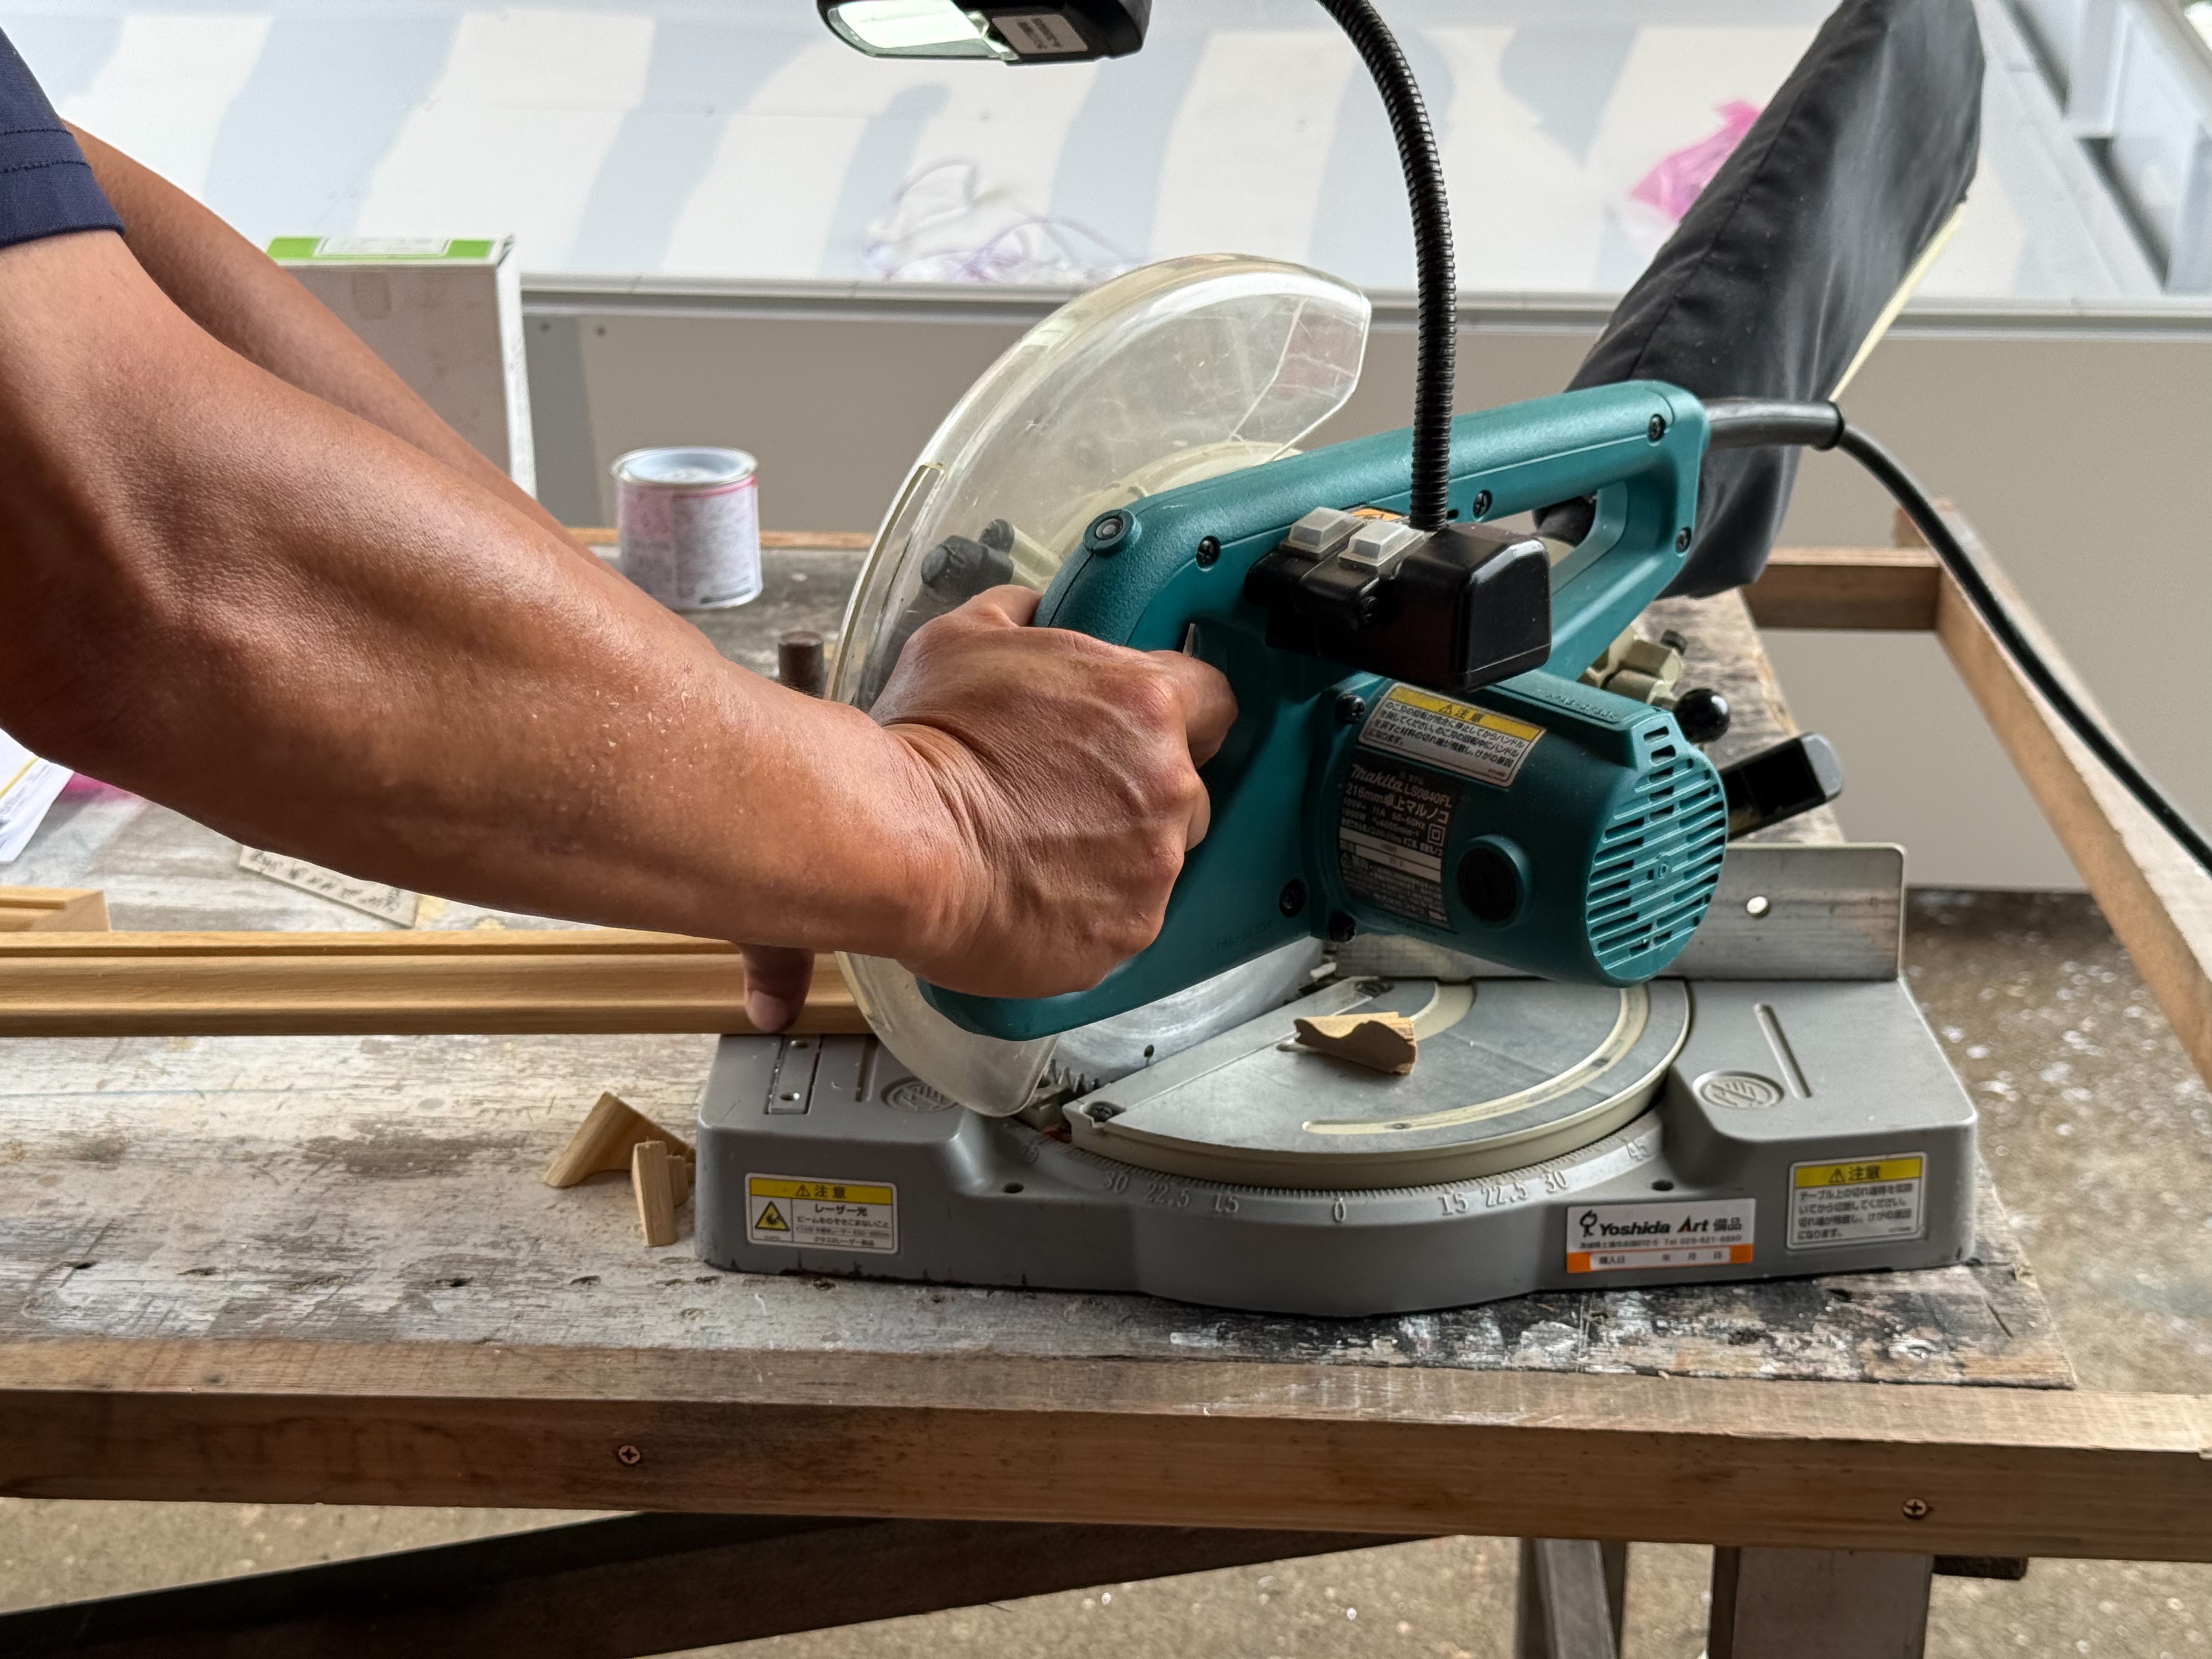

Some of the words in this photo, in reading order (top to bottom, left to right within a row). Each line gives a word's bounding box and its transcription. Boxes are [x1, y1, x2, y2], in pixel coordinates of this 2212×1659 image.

[1455, 707, 1485, 724] 注意
[1404, 783, 1453, 809] LS0840FL
[1627, 1140, 1650, 1161] 45
[1103, 1170, 1128, 1194] 30
[1544, 1170, 1568, 1194] 30
[1848, 1165, 1881, 1181] 注意
[814, 1184, 847, 1199] 注意
[1143, 1182, 1190, 1207] 22.5
[1481, 1182, 1528, 1207] 22.5
[814, 1203, 868, 1217] レーザー光
[1214, 1193, 1239, 1214] 15
[1333, 1200, 1347, 1222] 0
[1438, 1192, 1468, 1216] 15
[1599, 1220, 1671, 1236] Yoshida
[1677, 1214, 1709, 1233] Art
[1713, 1250, 1723, 1260] 日
